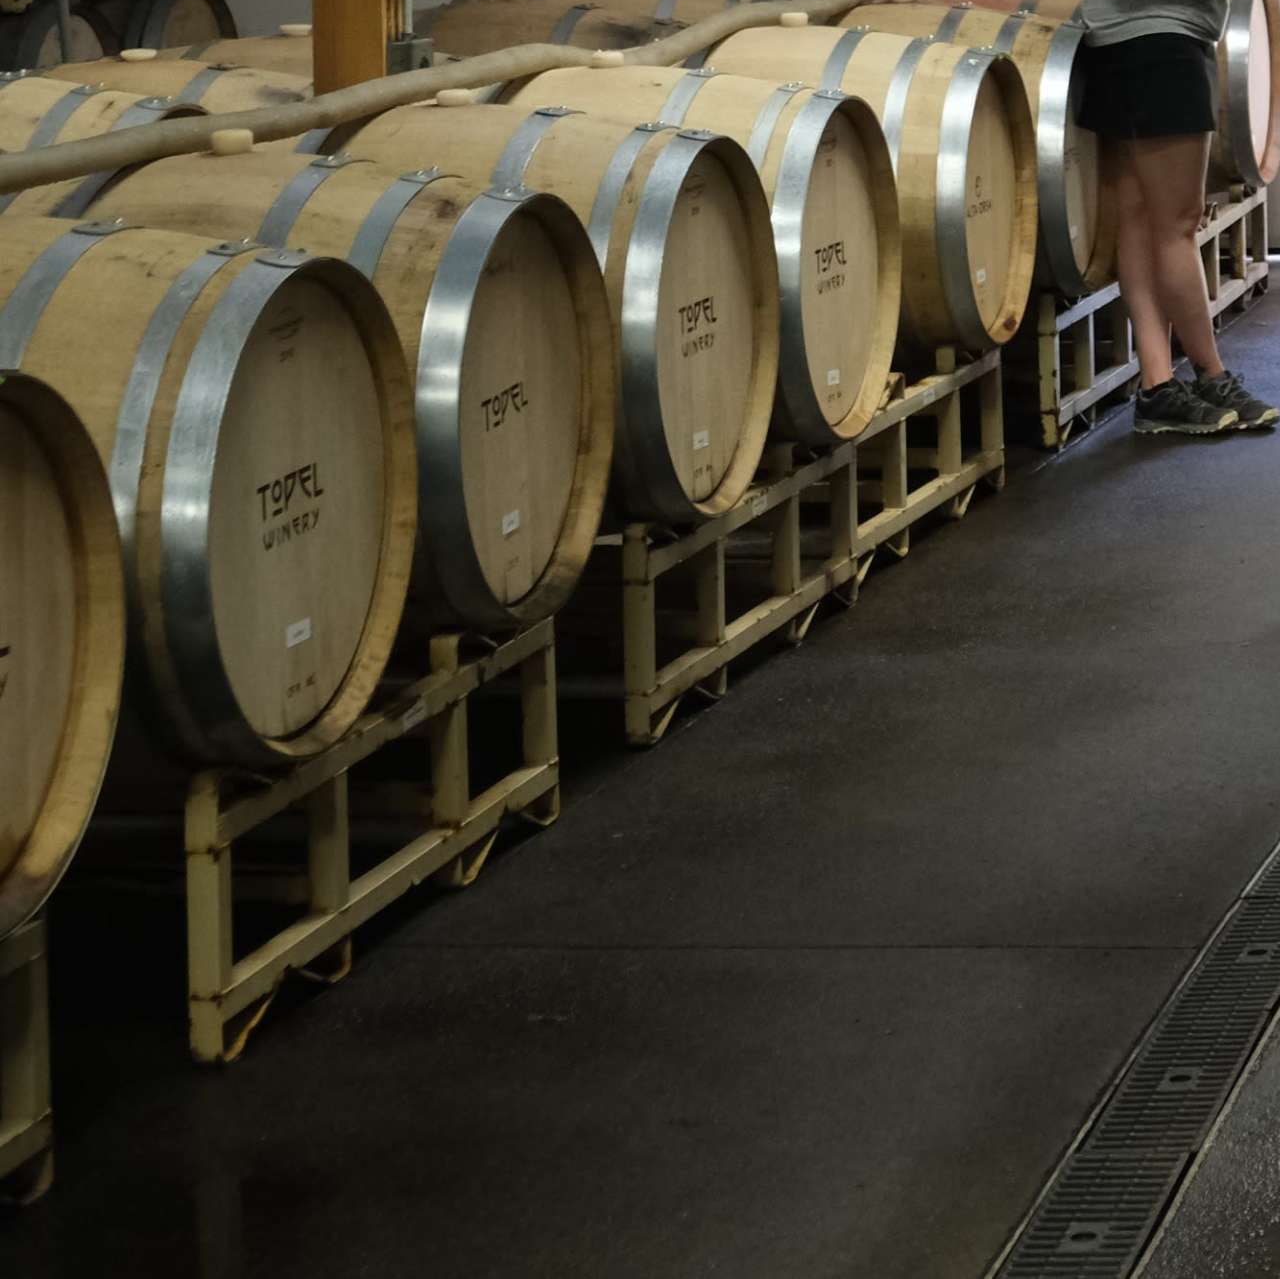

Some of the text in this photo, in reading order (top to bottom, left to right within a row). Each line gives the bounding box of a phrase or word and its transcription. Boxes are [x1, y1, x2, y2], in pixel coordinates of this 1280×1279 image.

[814, 240, 848, 275] TOPEL
[678, 296, 718, 334] TOPEL
[681, 332, 716, 358] WINERY
[480, 381, 529, 433] TOPEL
[256, 462, 324, 522] TOPEL
[262, 507, 321, 552] WINERY
